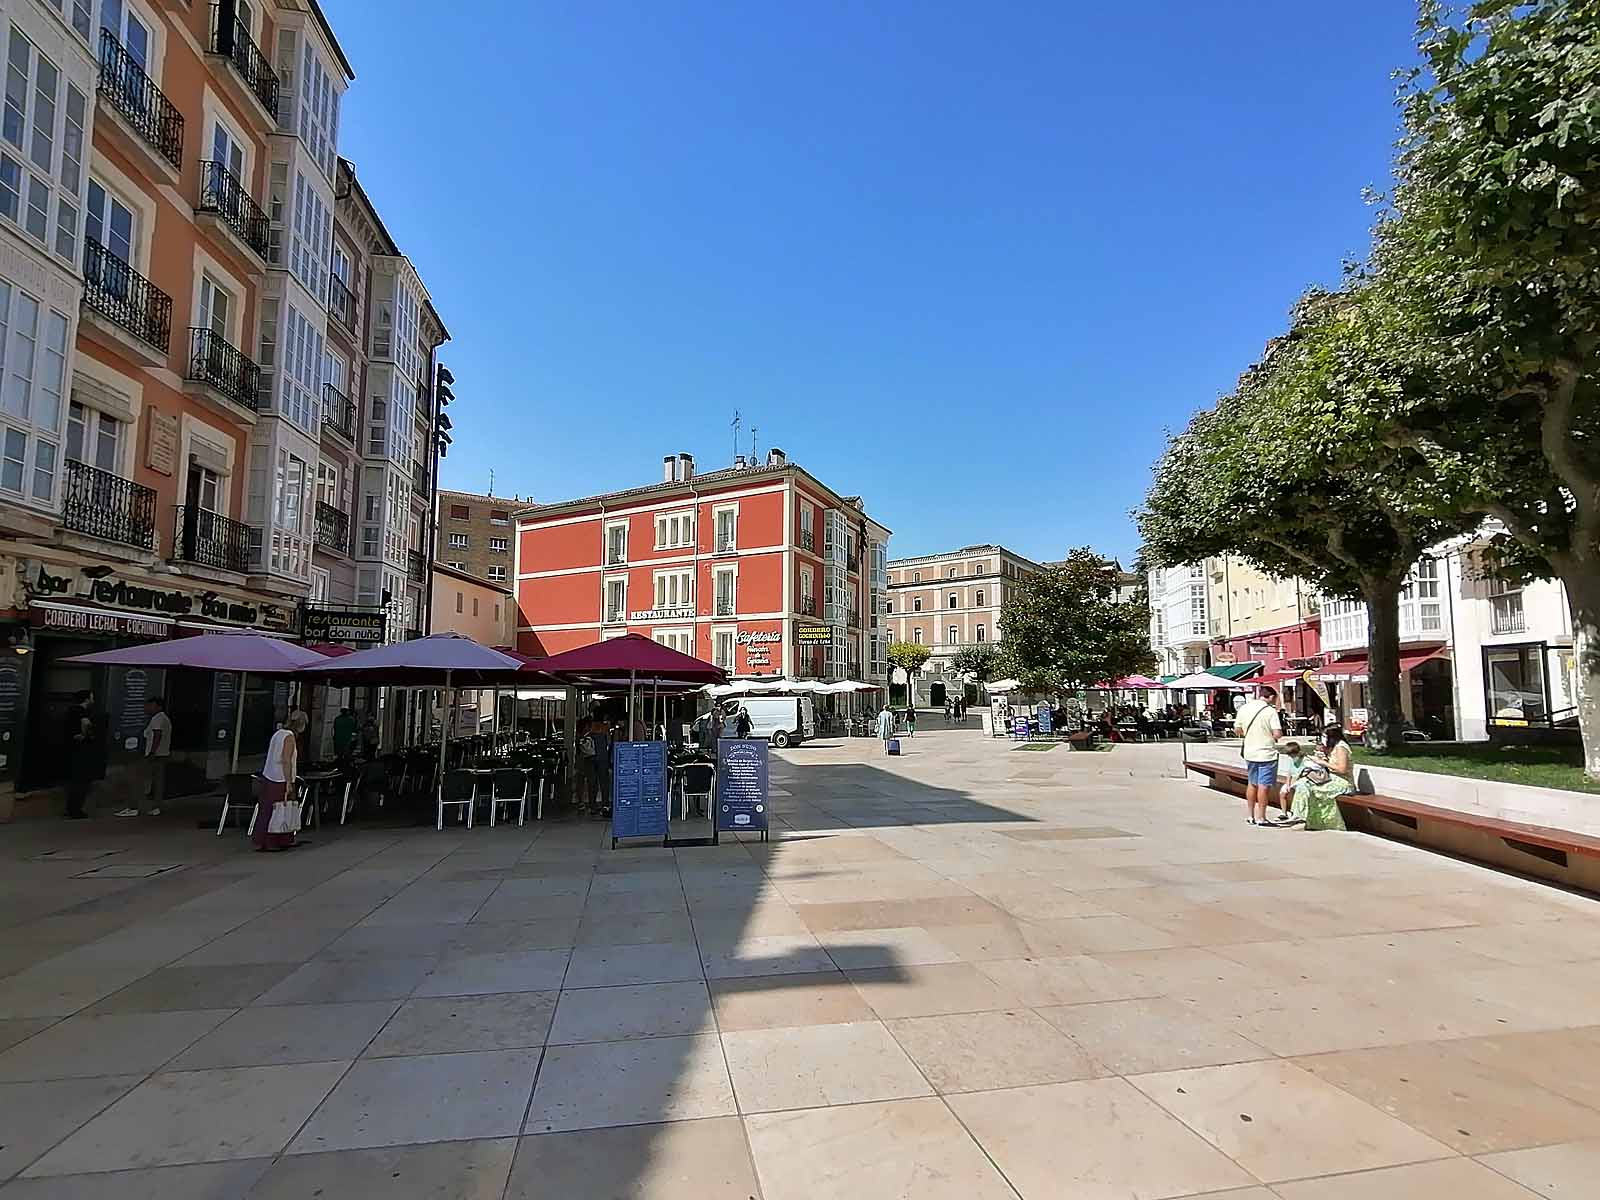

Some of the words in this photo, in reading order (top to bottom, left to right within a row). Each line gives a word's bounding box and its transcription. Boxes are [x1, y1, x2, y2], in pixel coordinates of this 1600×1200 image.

[38, 566, 72, 595] bar
[307, 614, 381, 627] restaurante
[631, 609, 695, 620] RESTAURANTE
[44, 608, 87, 629] CORDERO
[89, 613, 119, 632] LECHAL
[126, 618, 168, 637] COCHINILLO
[304, 625, 326, 638] bar
[329, 626, 351, 639] don
[354, 628, 381, 640] nuño
[736, 630, 781, 645] Cafetería
